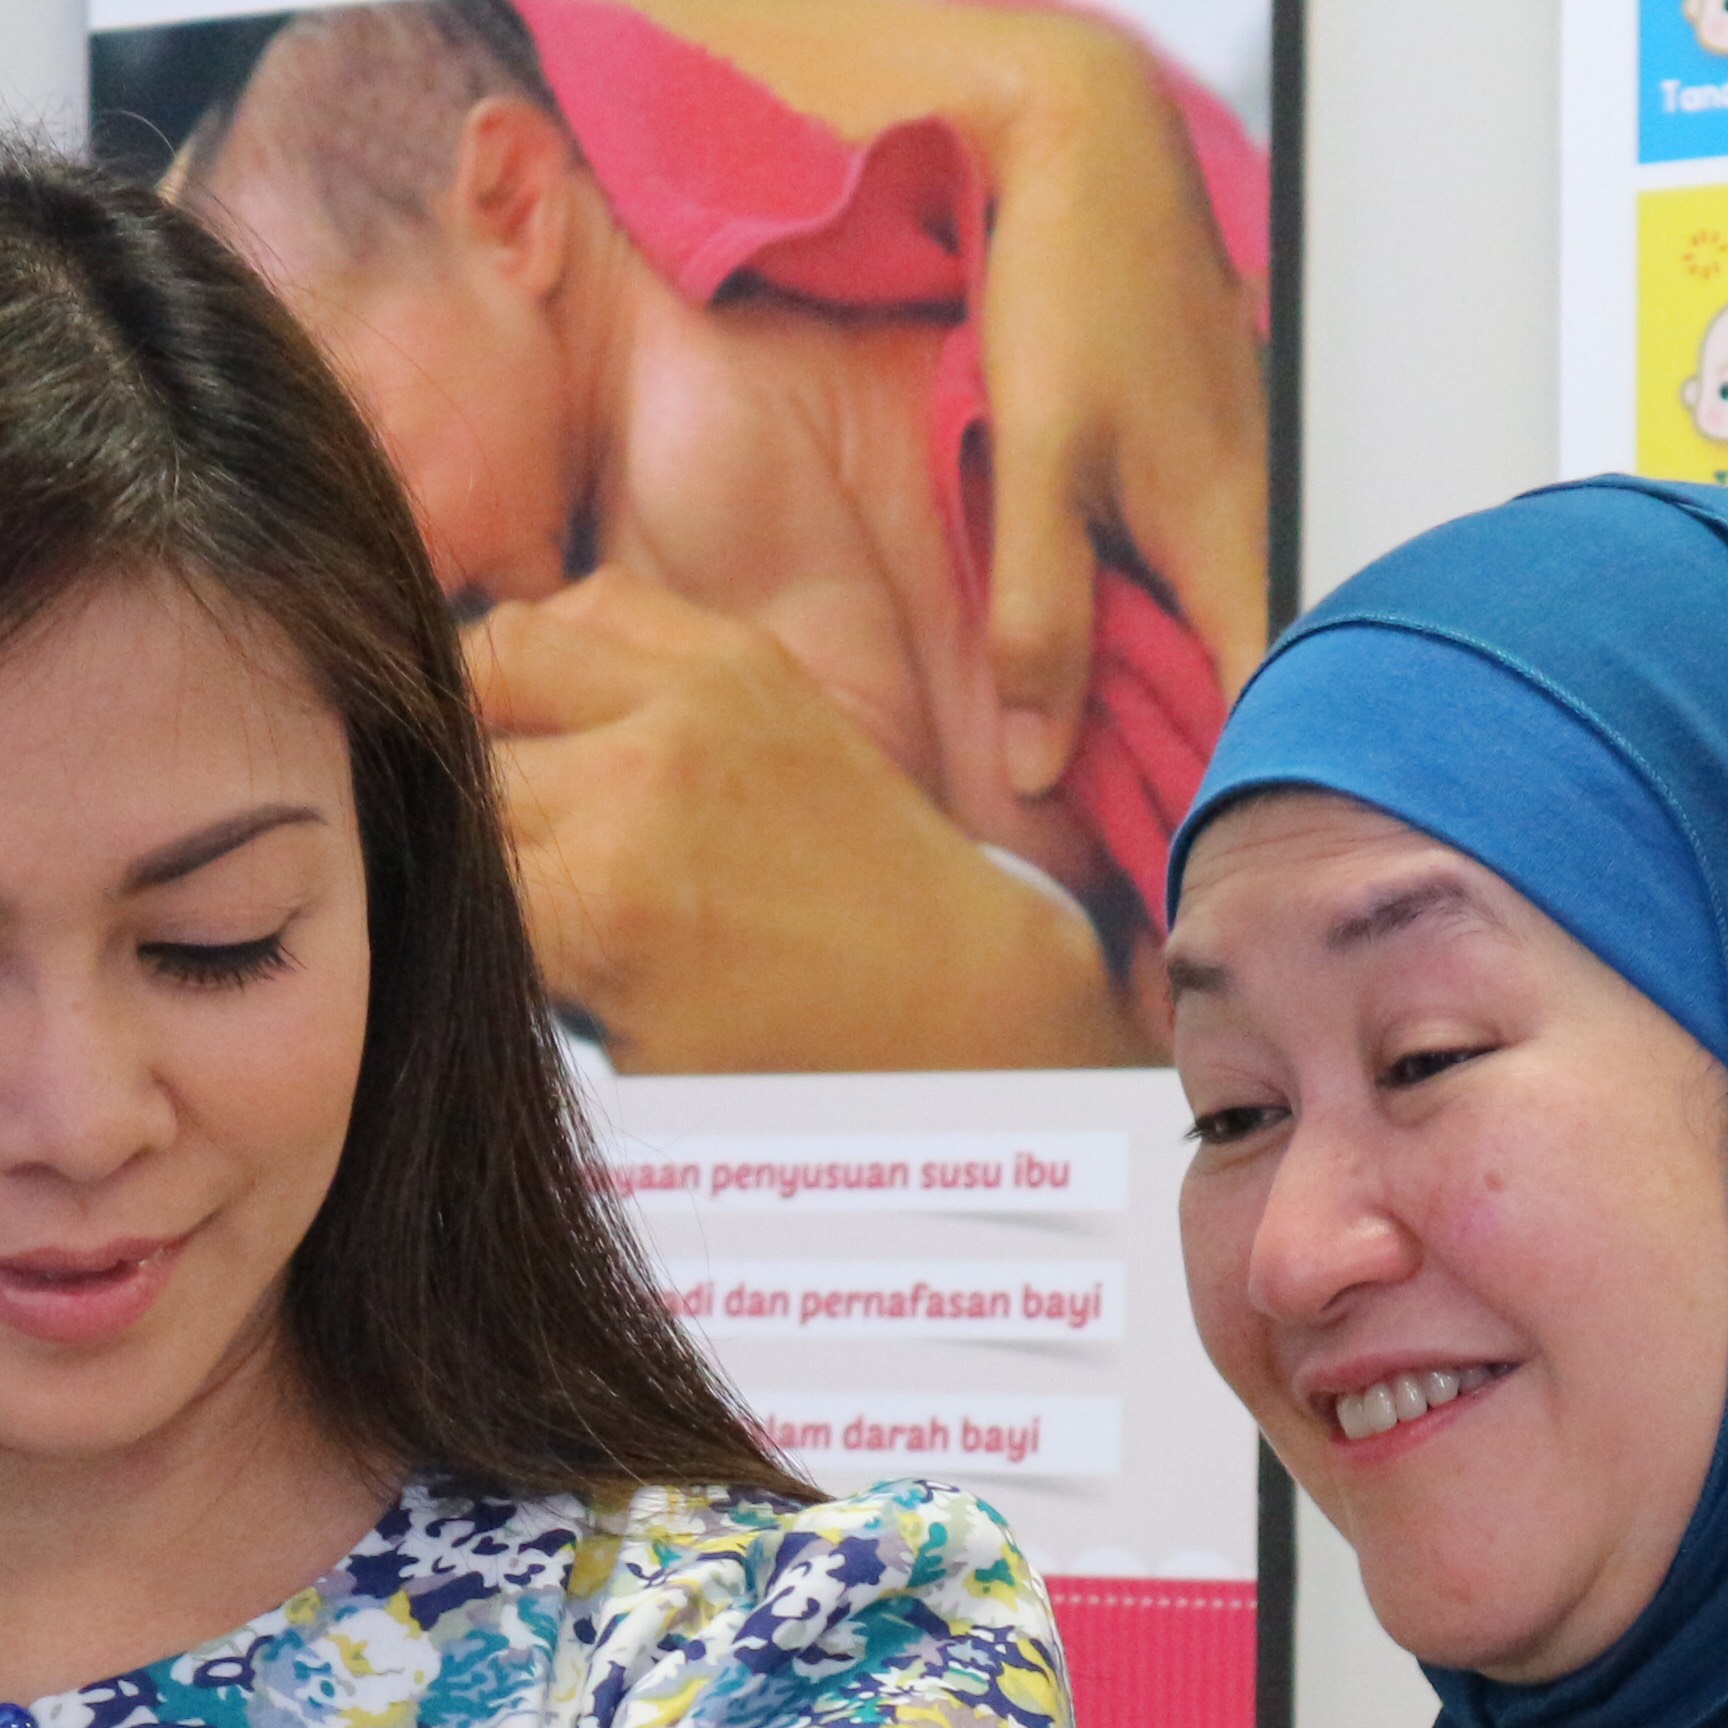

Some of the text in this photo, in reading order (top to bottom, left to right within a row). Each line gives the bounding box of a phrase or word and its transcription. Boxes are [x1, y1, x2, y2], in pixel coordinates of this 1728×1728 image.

[711, 1162, 909, 1198] penyusuan
[922, 1160, 1002, 1190] susu
[1014, 1152, 1070, 1188] ibu
[725, 1283, 789, 1317] dan
[799, 1283, 1012, 1323] pernafasan
[1024, 1283, 1101, 1326] bayi
[843, 1415, 948, 1450] darah
[962, 1418, 1040, 1460] bayi
